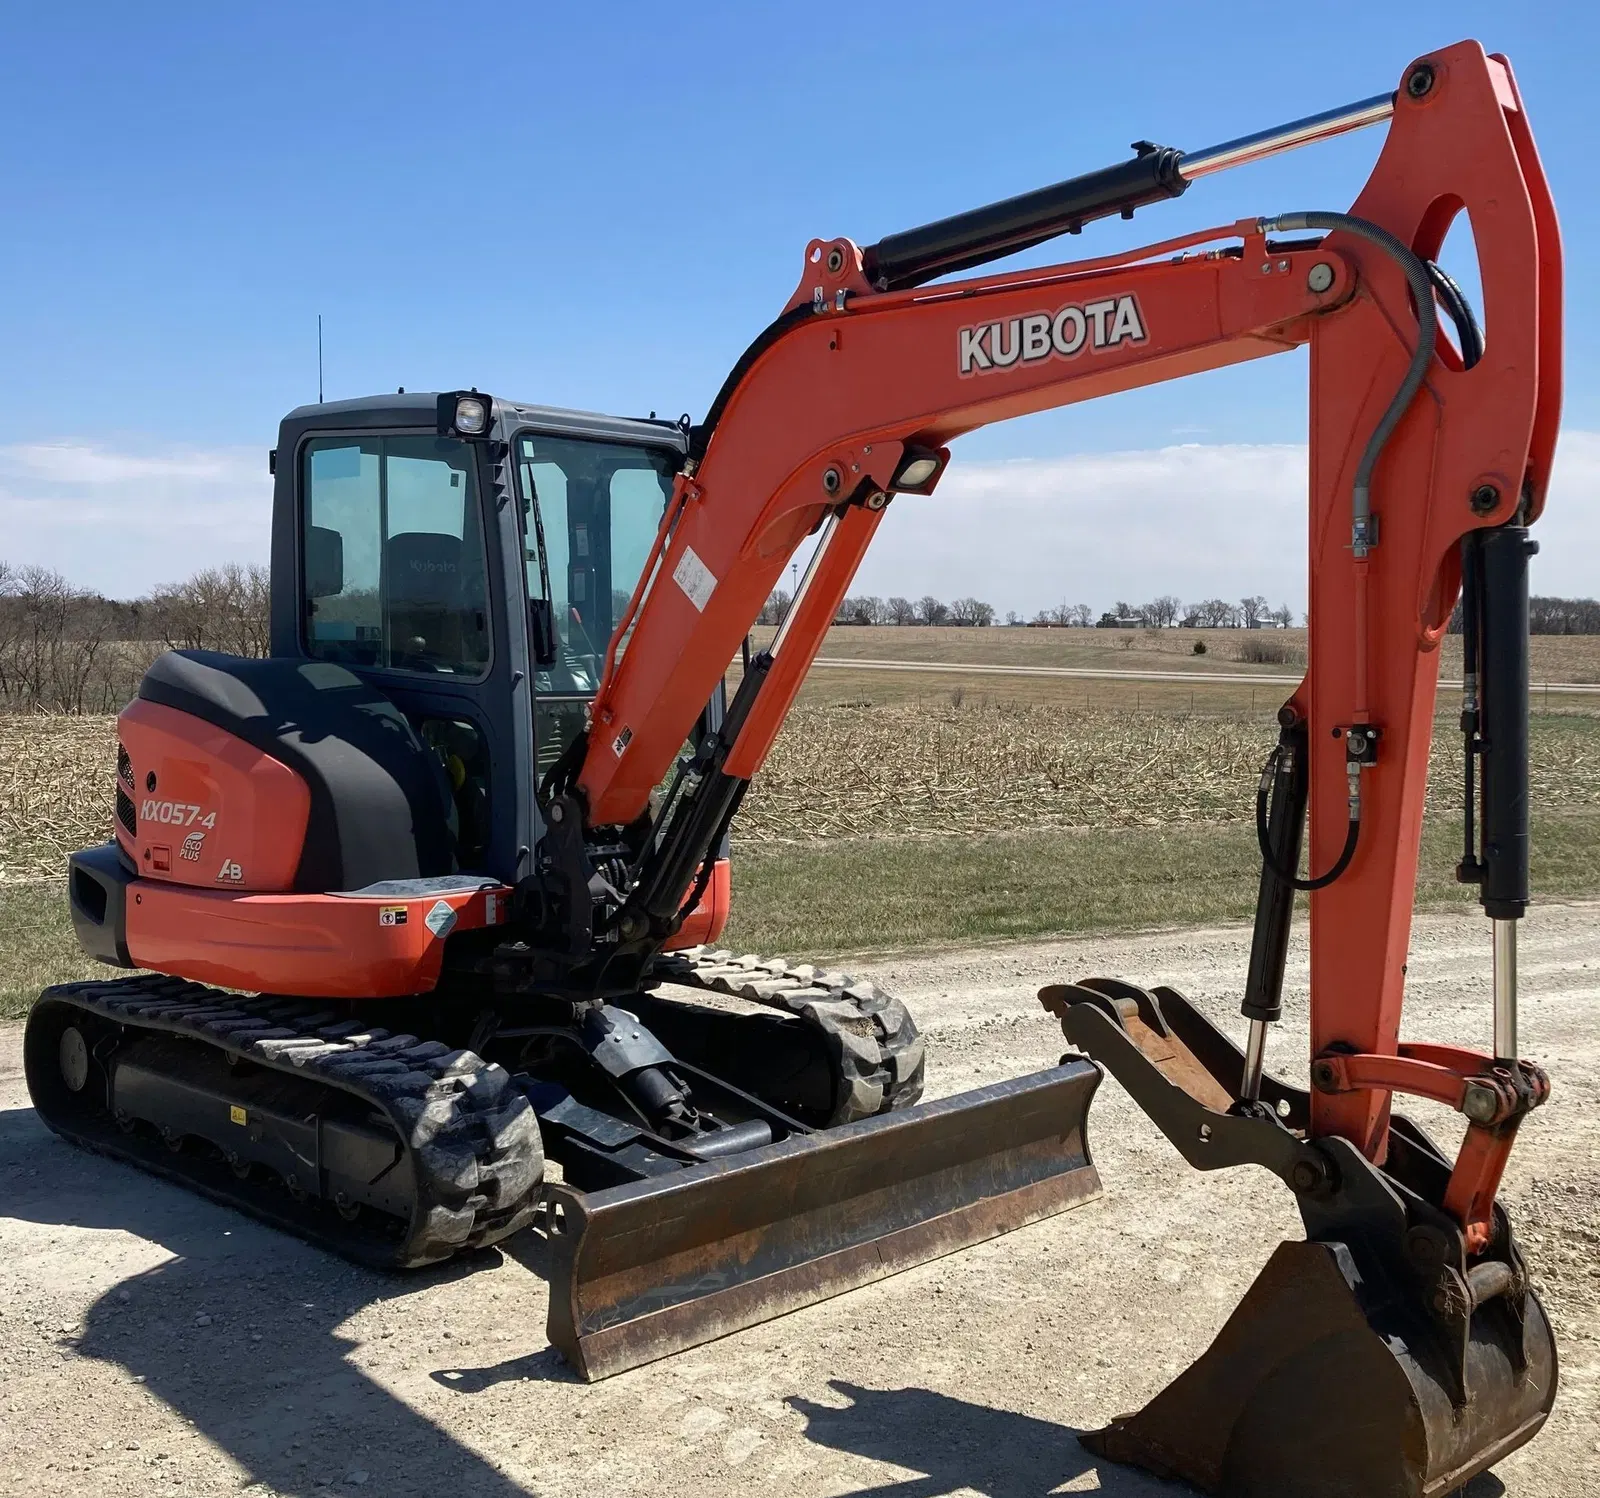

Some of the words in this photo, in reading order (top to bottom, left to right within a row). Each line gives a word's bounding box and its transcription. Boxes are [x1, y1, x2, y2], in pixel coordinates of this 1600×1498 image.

[960, 295, 1146, 373] KUBOTA
[140, 799, 216, 829] KX057-4
[179, 849, 200, 861] PLUS
[217, 858, 243, 880] AB
